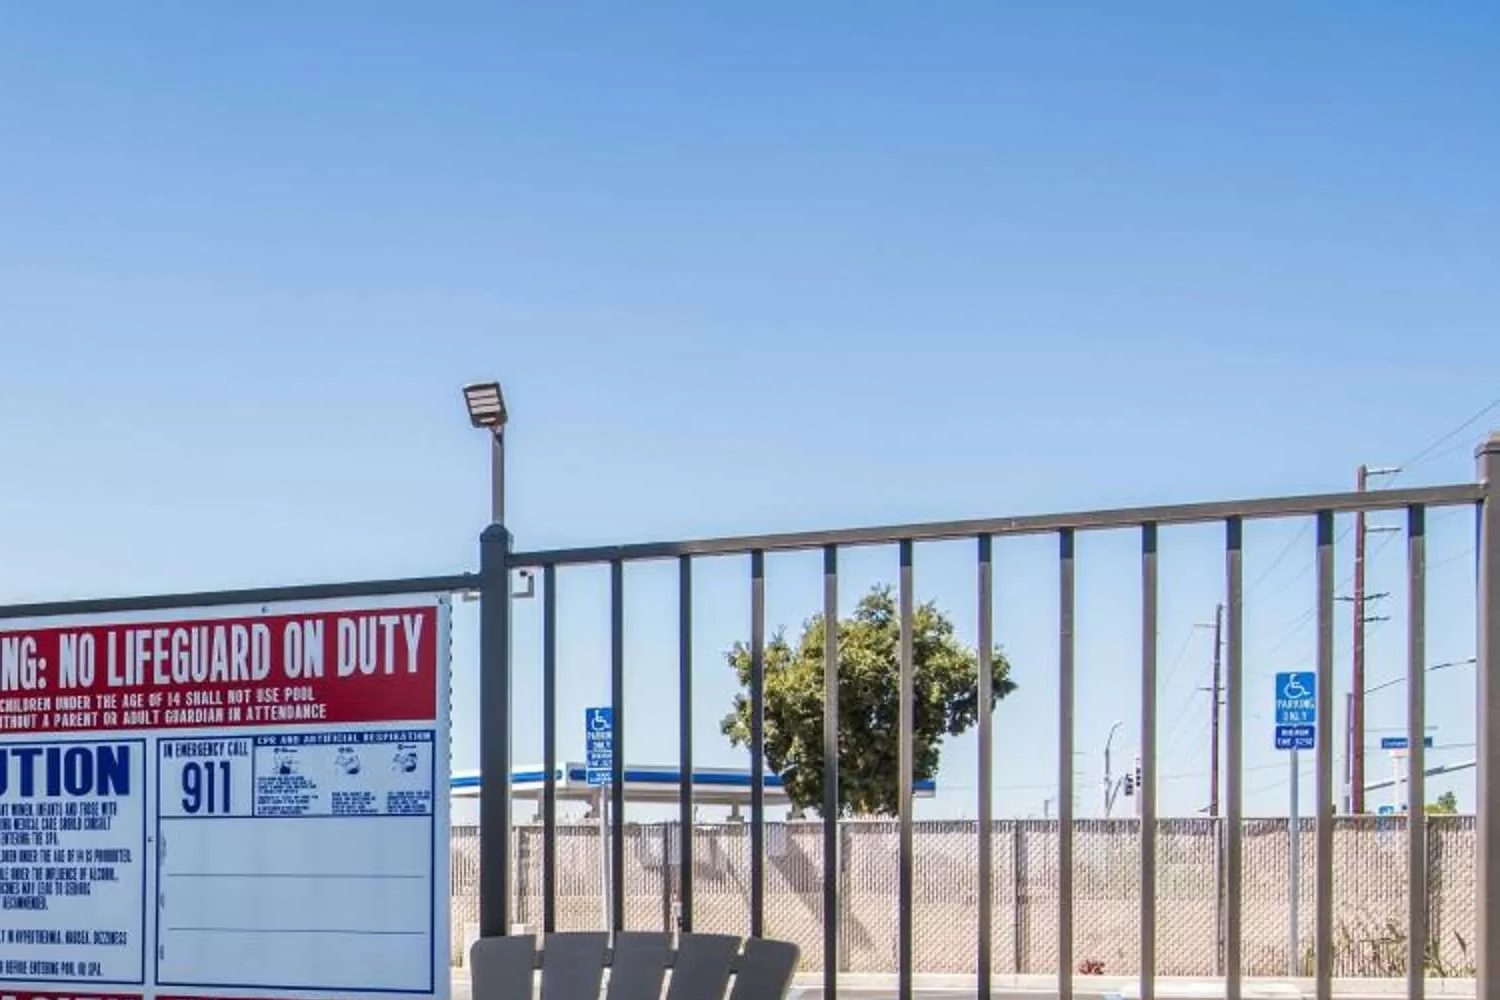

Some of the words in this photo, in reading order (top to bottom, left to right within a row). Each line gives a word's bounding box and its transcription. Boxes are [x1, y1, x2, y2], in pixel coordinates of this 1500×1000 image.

[59, 632, 96, 689] NO
[106, 623, 271, 688] LIFEGUARD
[283, 619, 324, 679] ON
[337, 613, 424, 677] DUTY
[0, 696, 51, 713] CHILDREN
[56, 695, 91, 711] UNDER
[97, 693, 117, 709] THE
[122, 692, 145, 709] AGE
[148, 692, 162, 707] OF
[168, 691, 181, 706] 14
[185, 690, 223, 707] SHALL
[228, 688, 251, 704] NOT
[257, 687, 280, 703] USE
[284, 686, 316, 702] POOL
[41, 712, 49, 728] A
[54, 711, 99, 728] PARENT
[103, 710, 117, 726] OR
[122, 708, 160, 726] ADULT
[164, 706, 223, 724] GUARDIAN
[228, 706, 241, 722] IN
[245, 703, 327, 721] ATTENDANCE
[163, 743, 173, 758] IN
[176, 741, 225, 758] EMERGENCY
[228, 741, 248, 757] CALL
[182, 761, 231, 814] 911
